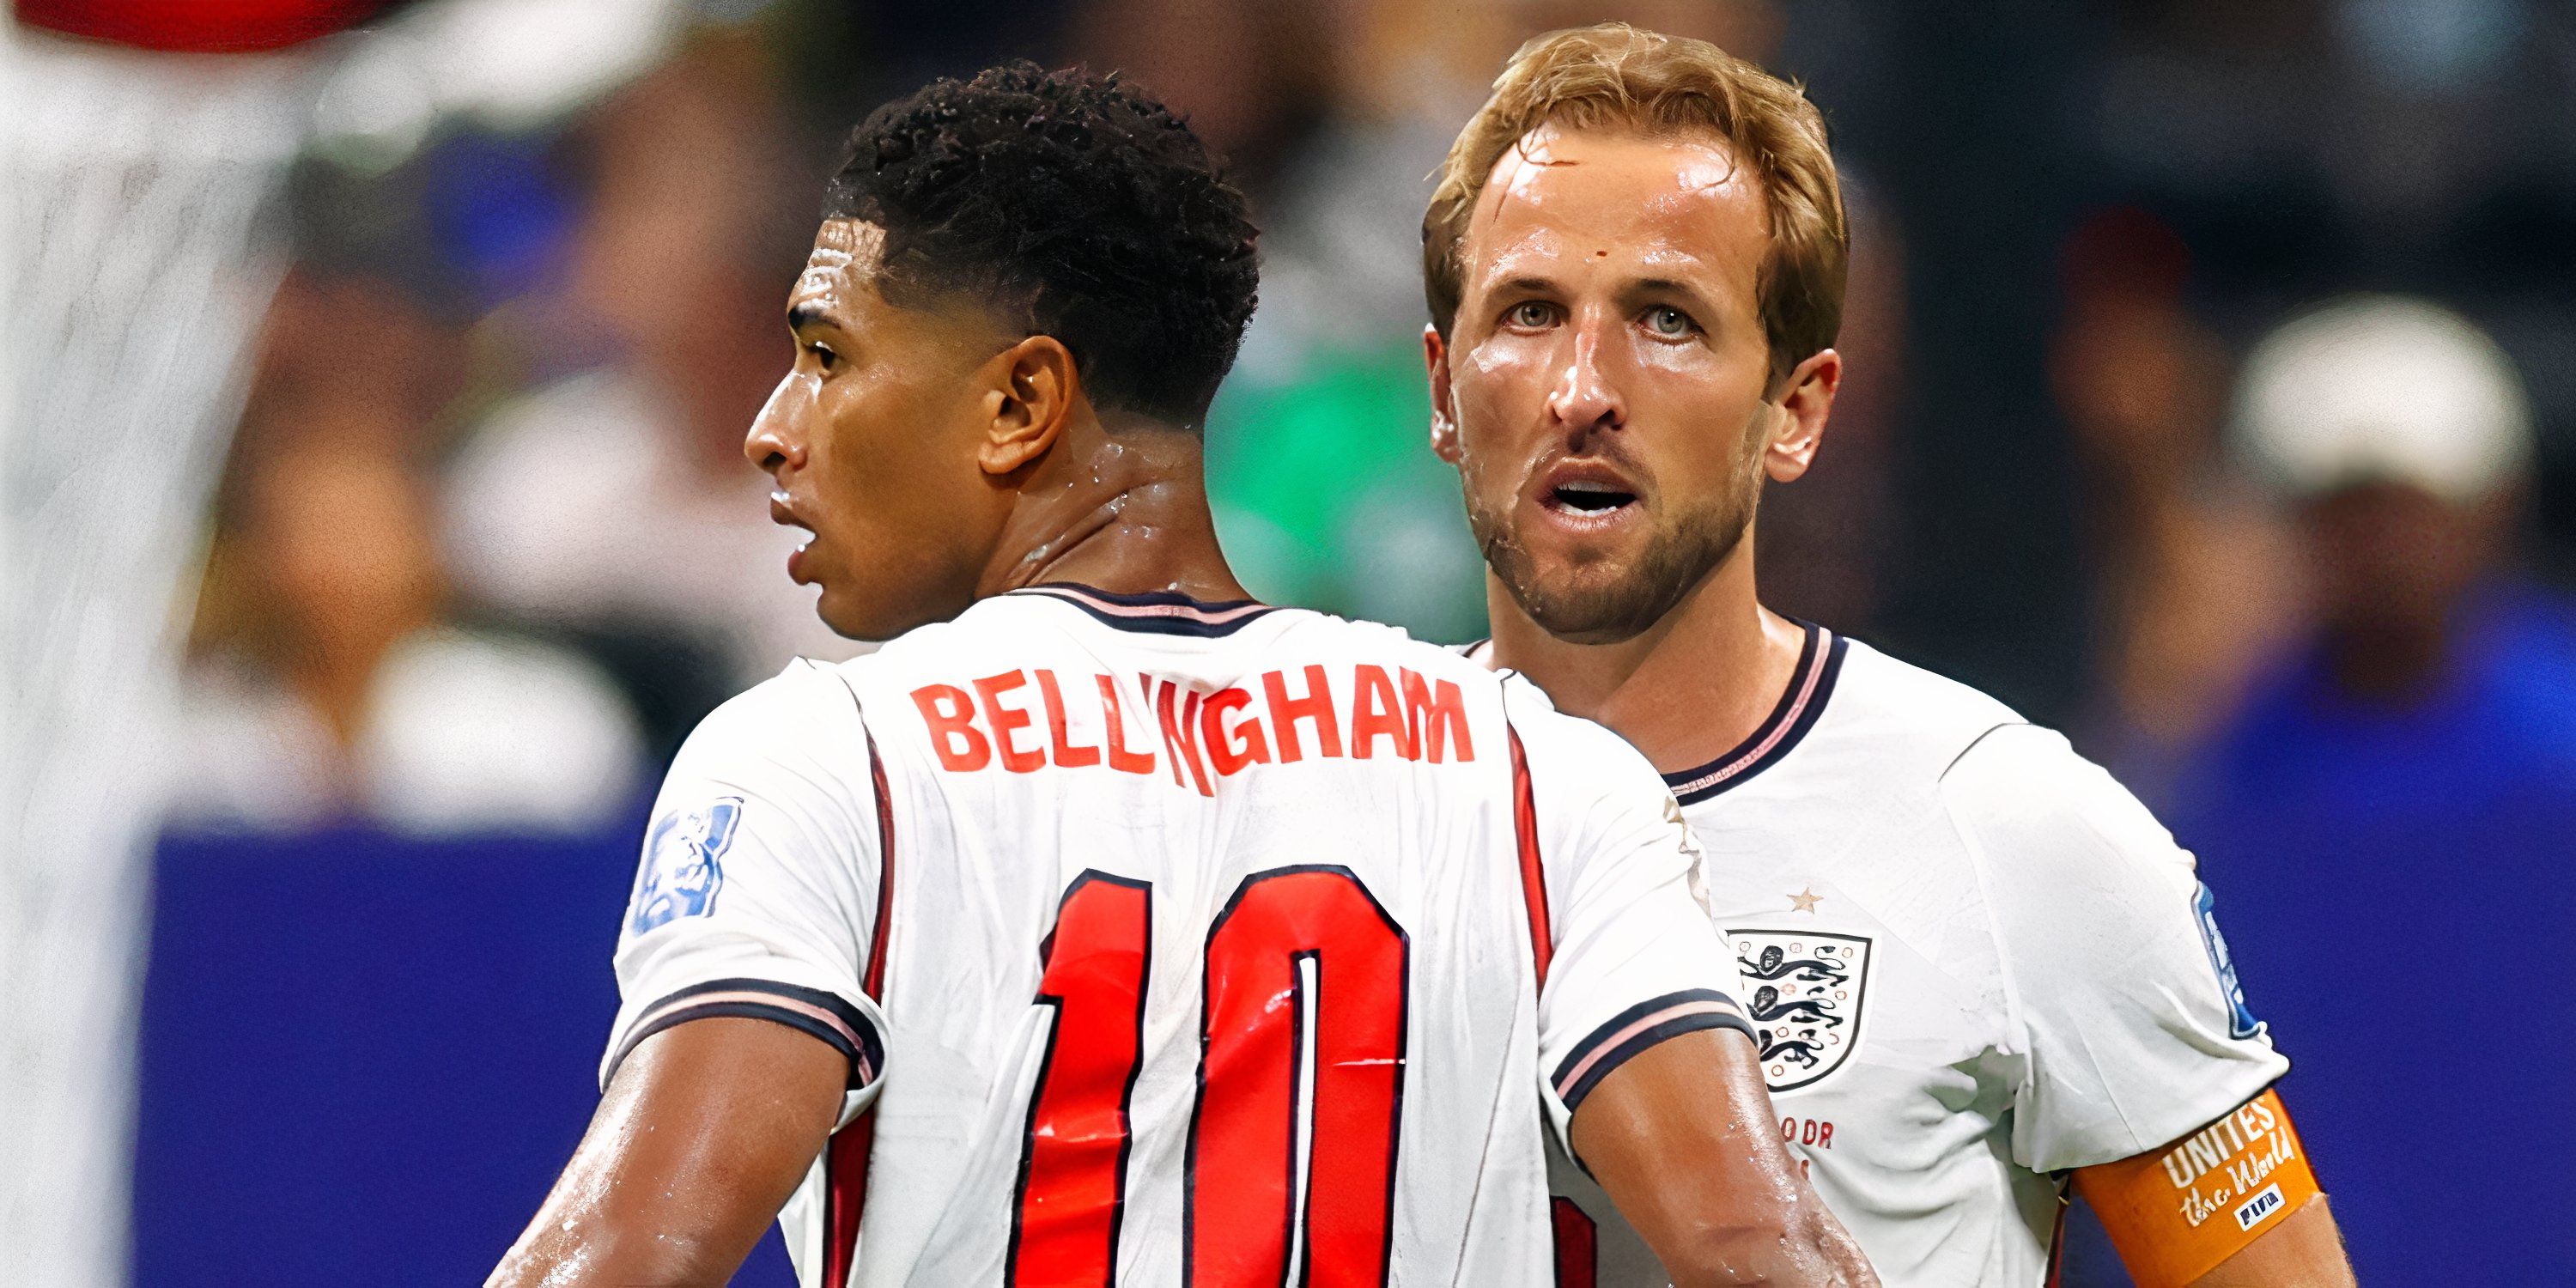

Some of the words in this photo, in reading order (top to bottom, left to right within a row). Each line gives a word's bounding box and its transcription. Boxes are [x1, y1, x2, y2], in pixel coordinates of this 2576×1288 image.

[1005, 864, 1410, 1288] 10
[2162, 1097, 2275, 1188] UNITES
[2226, 1126, 2295, 1195] World
